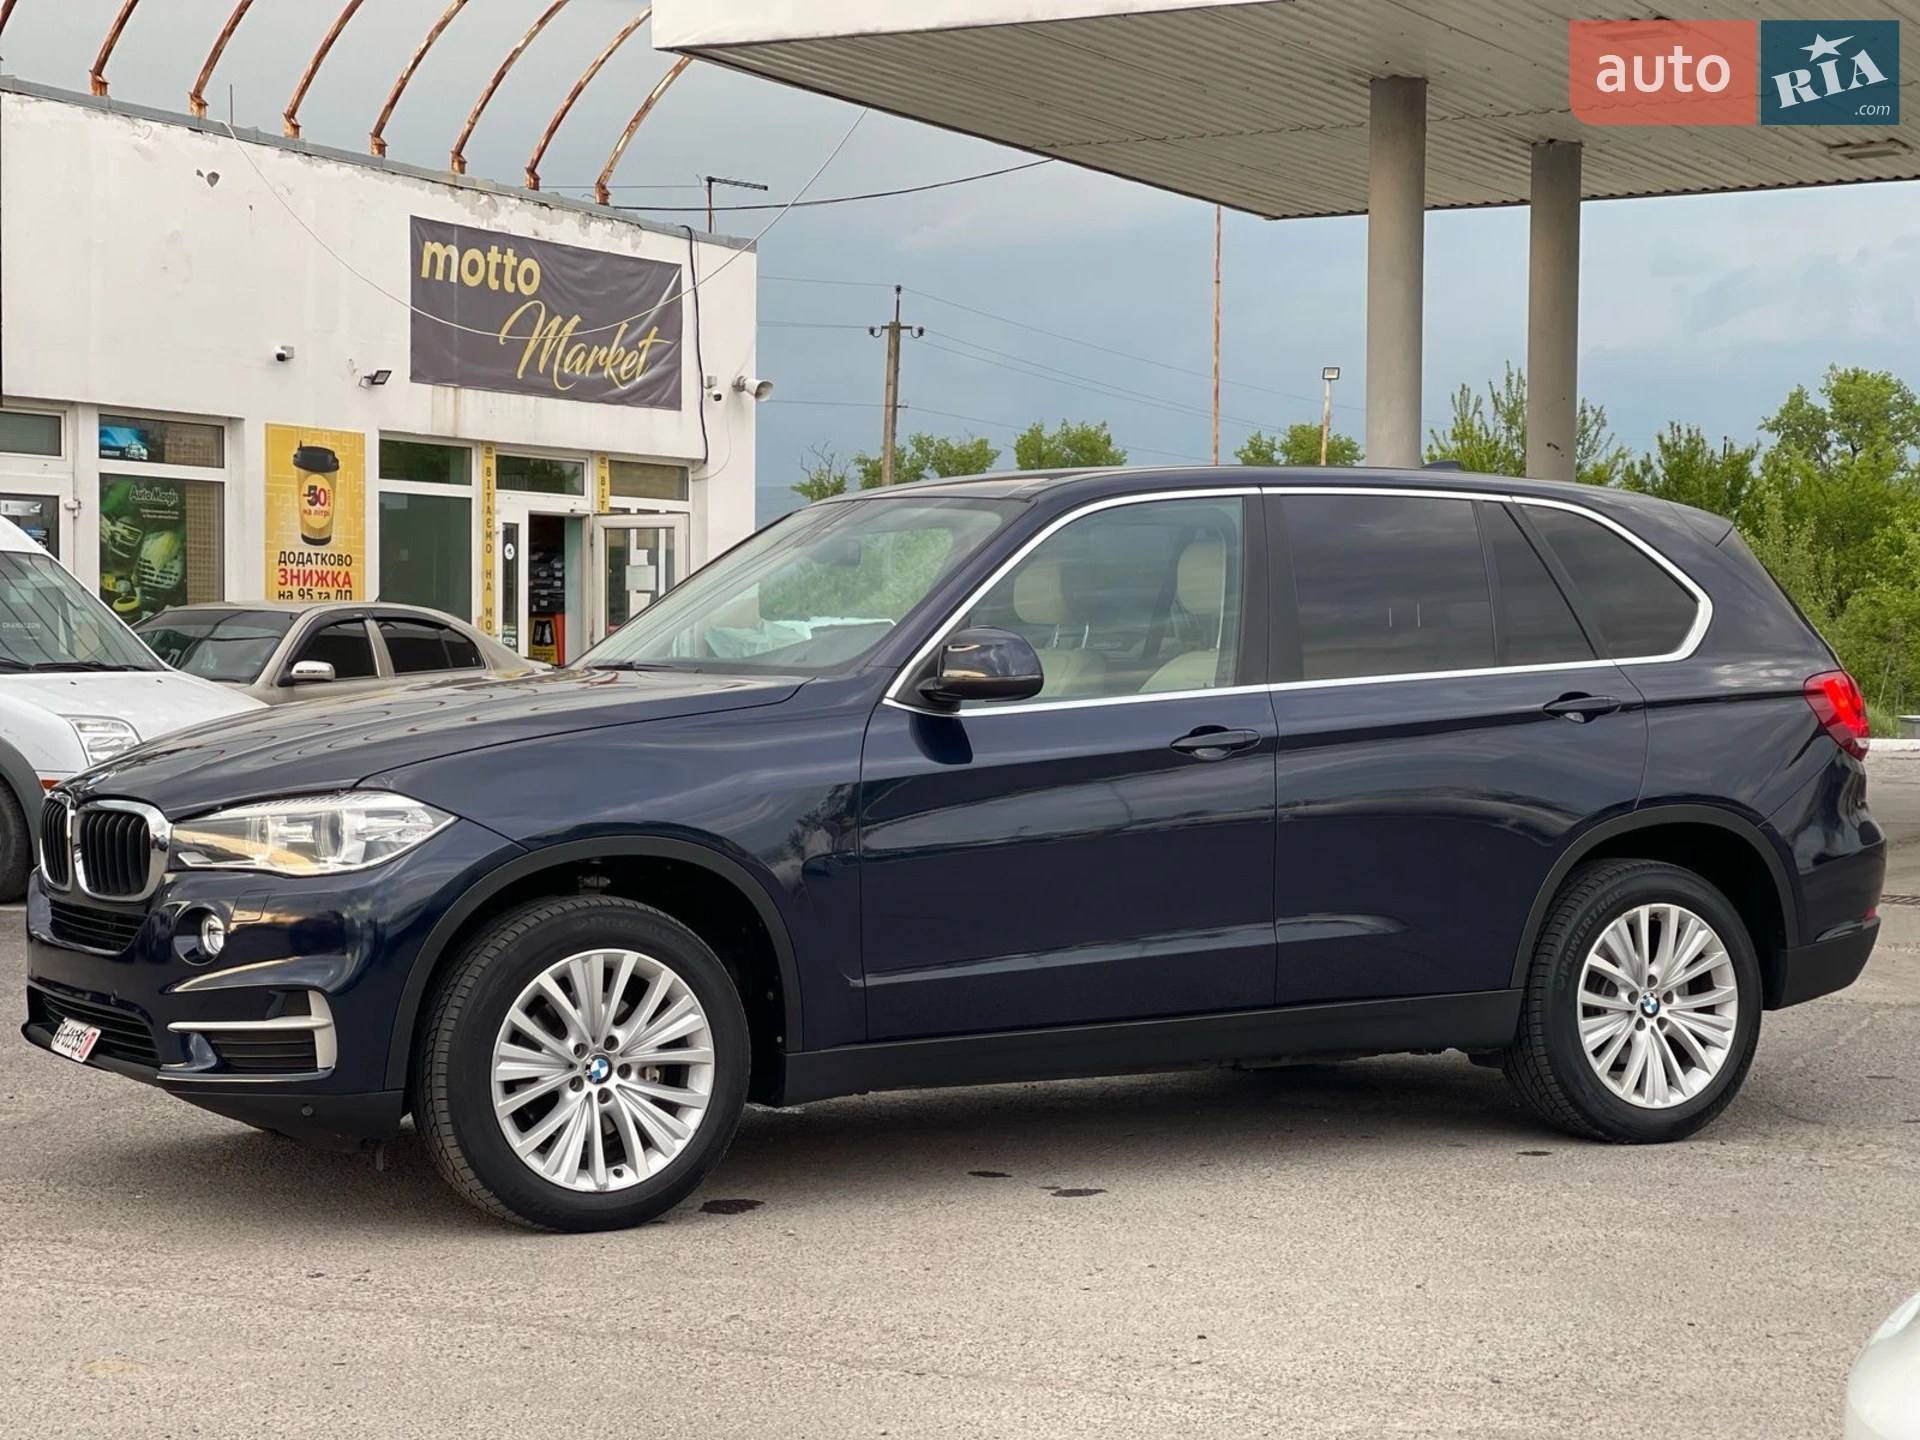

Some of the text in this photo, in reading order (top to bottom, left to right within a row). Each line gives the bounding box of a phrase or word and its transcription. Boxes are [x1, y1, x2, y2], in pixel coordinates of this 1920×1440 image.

[421, 240, 541, 296] motto
[499, 300, 673, 391] Market
[278, 551, 353, 567] ДОДАТКОВО
[278, 568, 353, 588] ЗНИЖКА
[278, 590, 294, 600] на
[297, 588, 314, 600] 95
[317, 591, 331, 600] та
